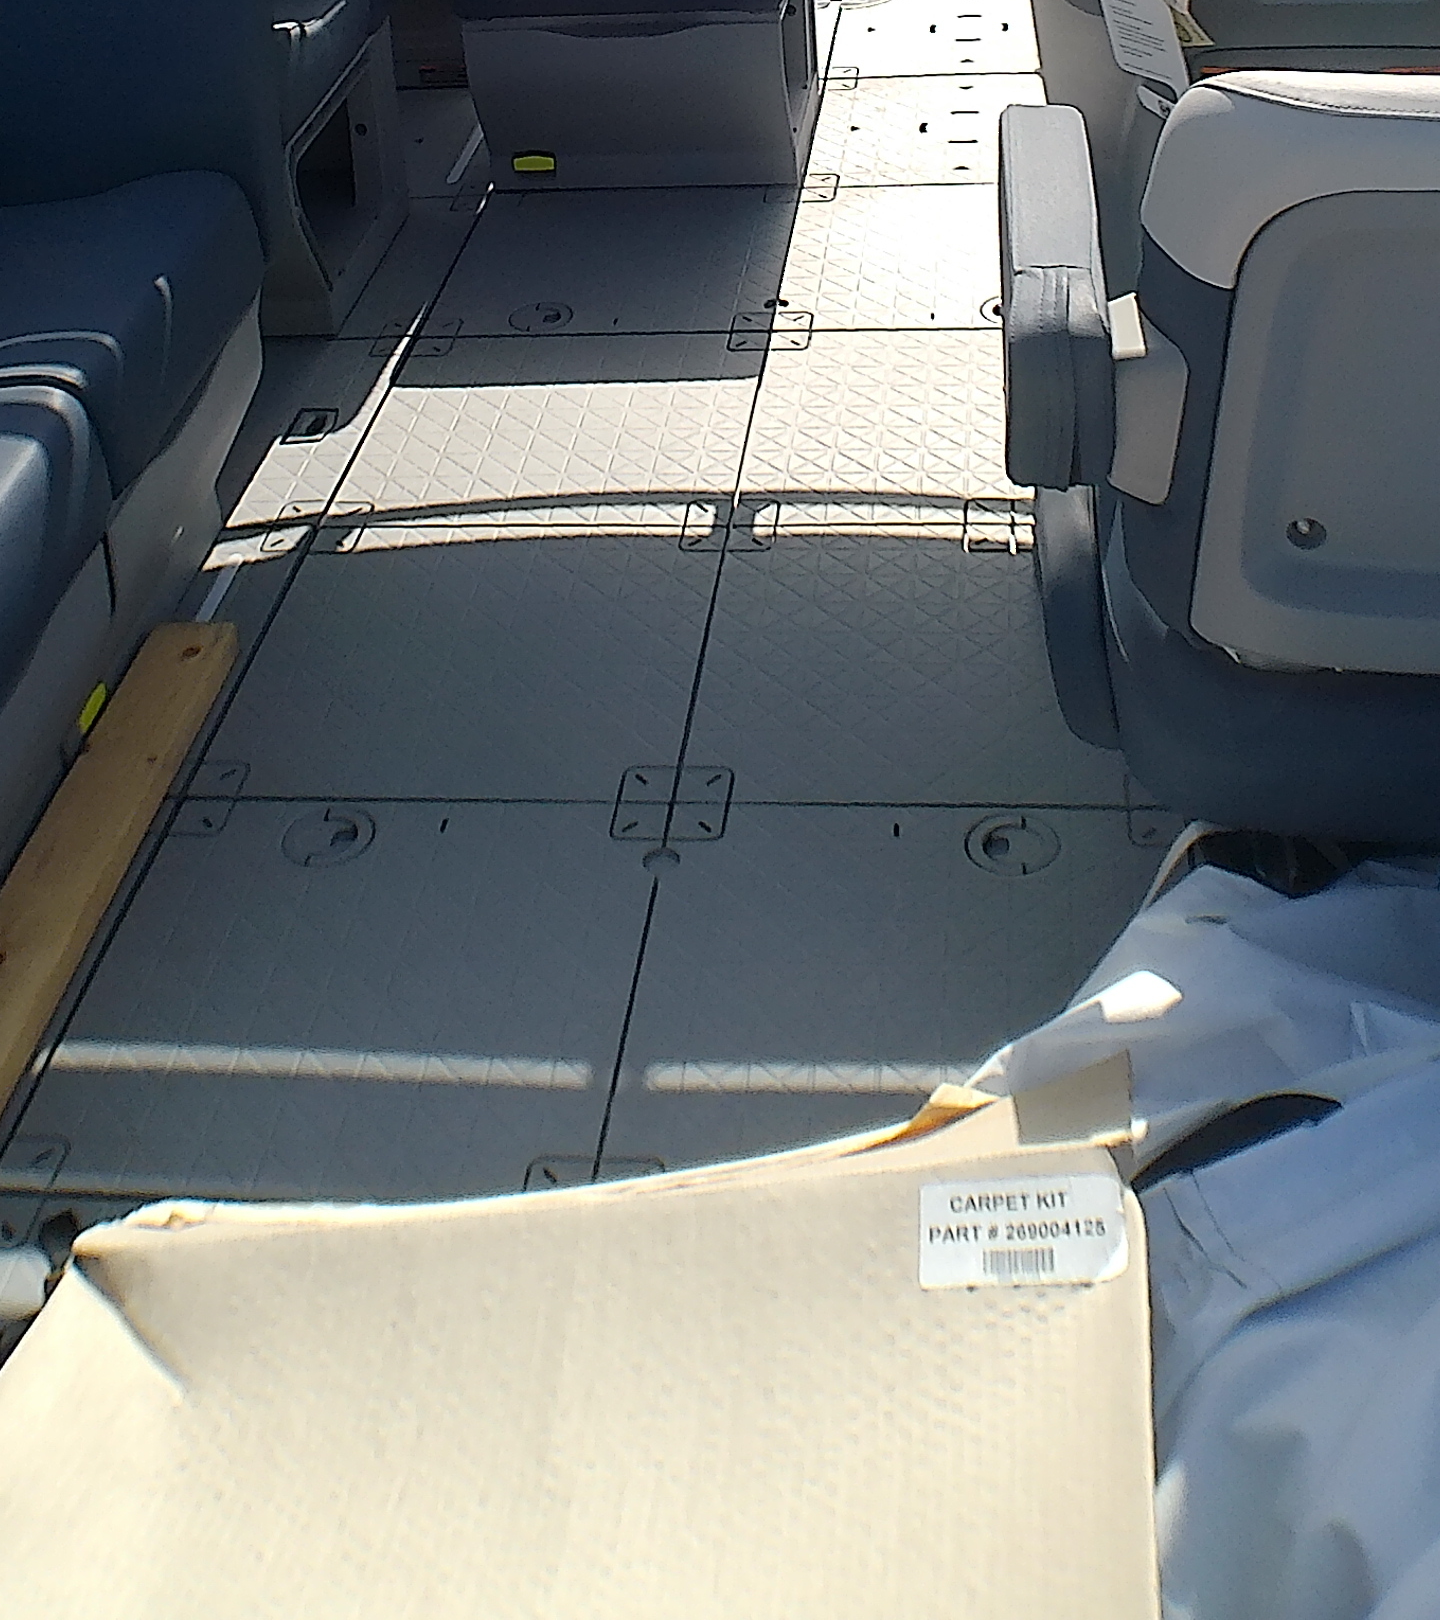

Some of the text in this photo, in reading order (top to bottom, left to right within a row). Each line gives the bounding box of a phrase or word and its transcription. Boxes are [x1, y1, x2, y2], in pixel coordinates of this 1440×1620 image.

[949, 1190, 1068, 1214] CARPET KIT
[928, 1223, 983, 1245] PART
